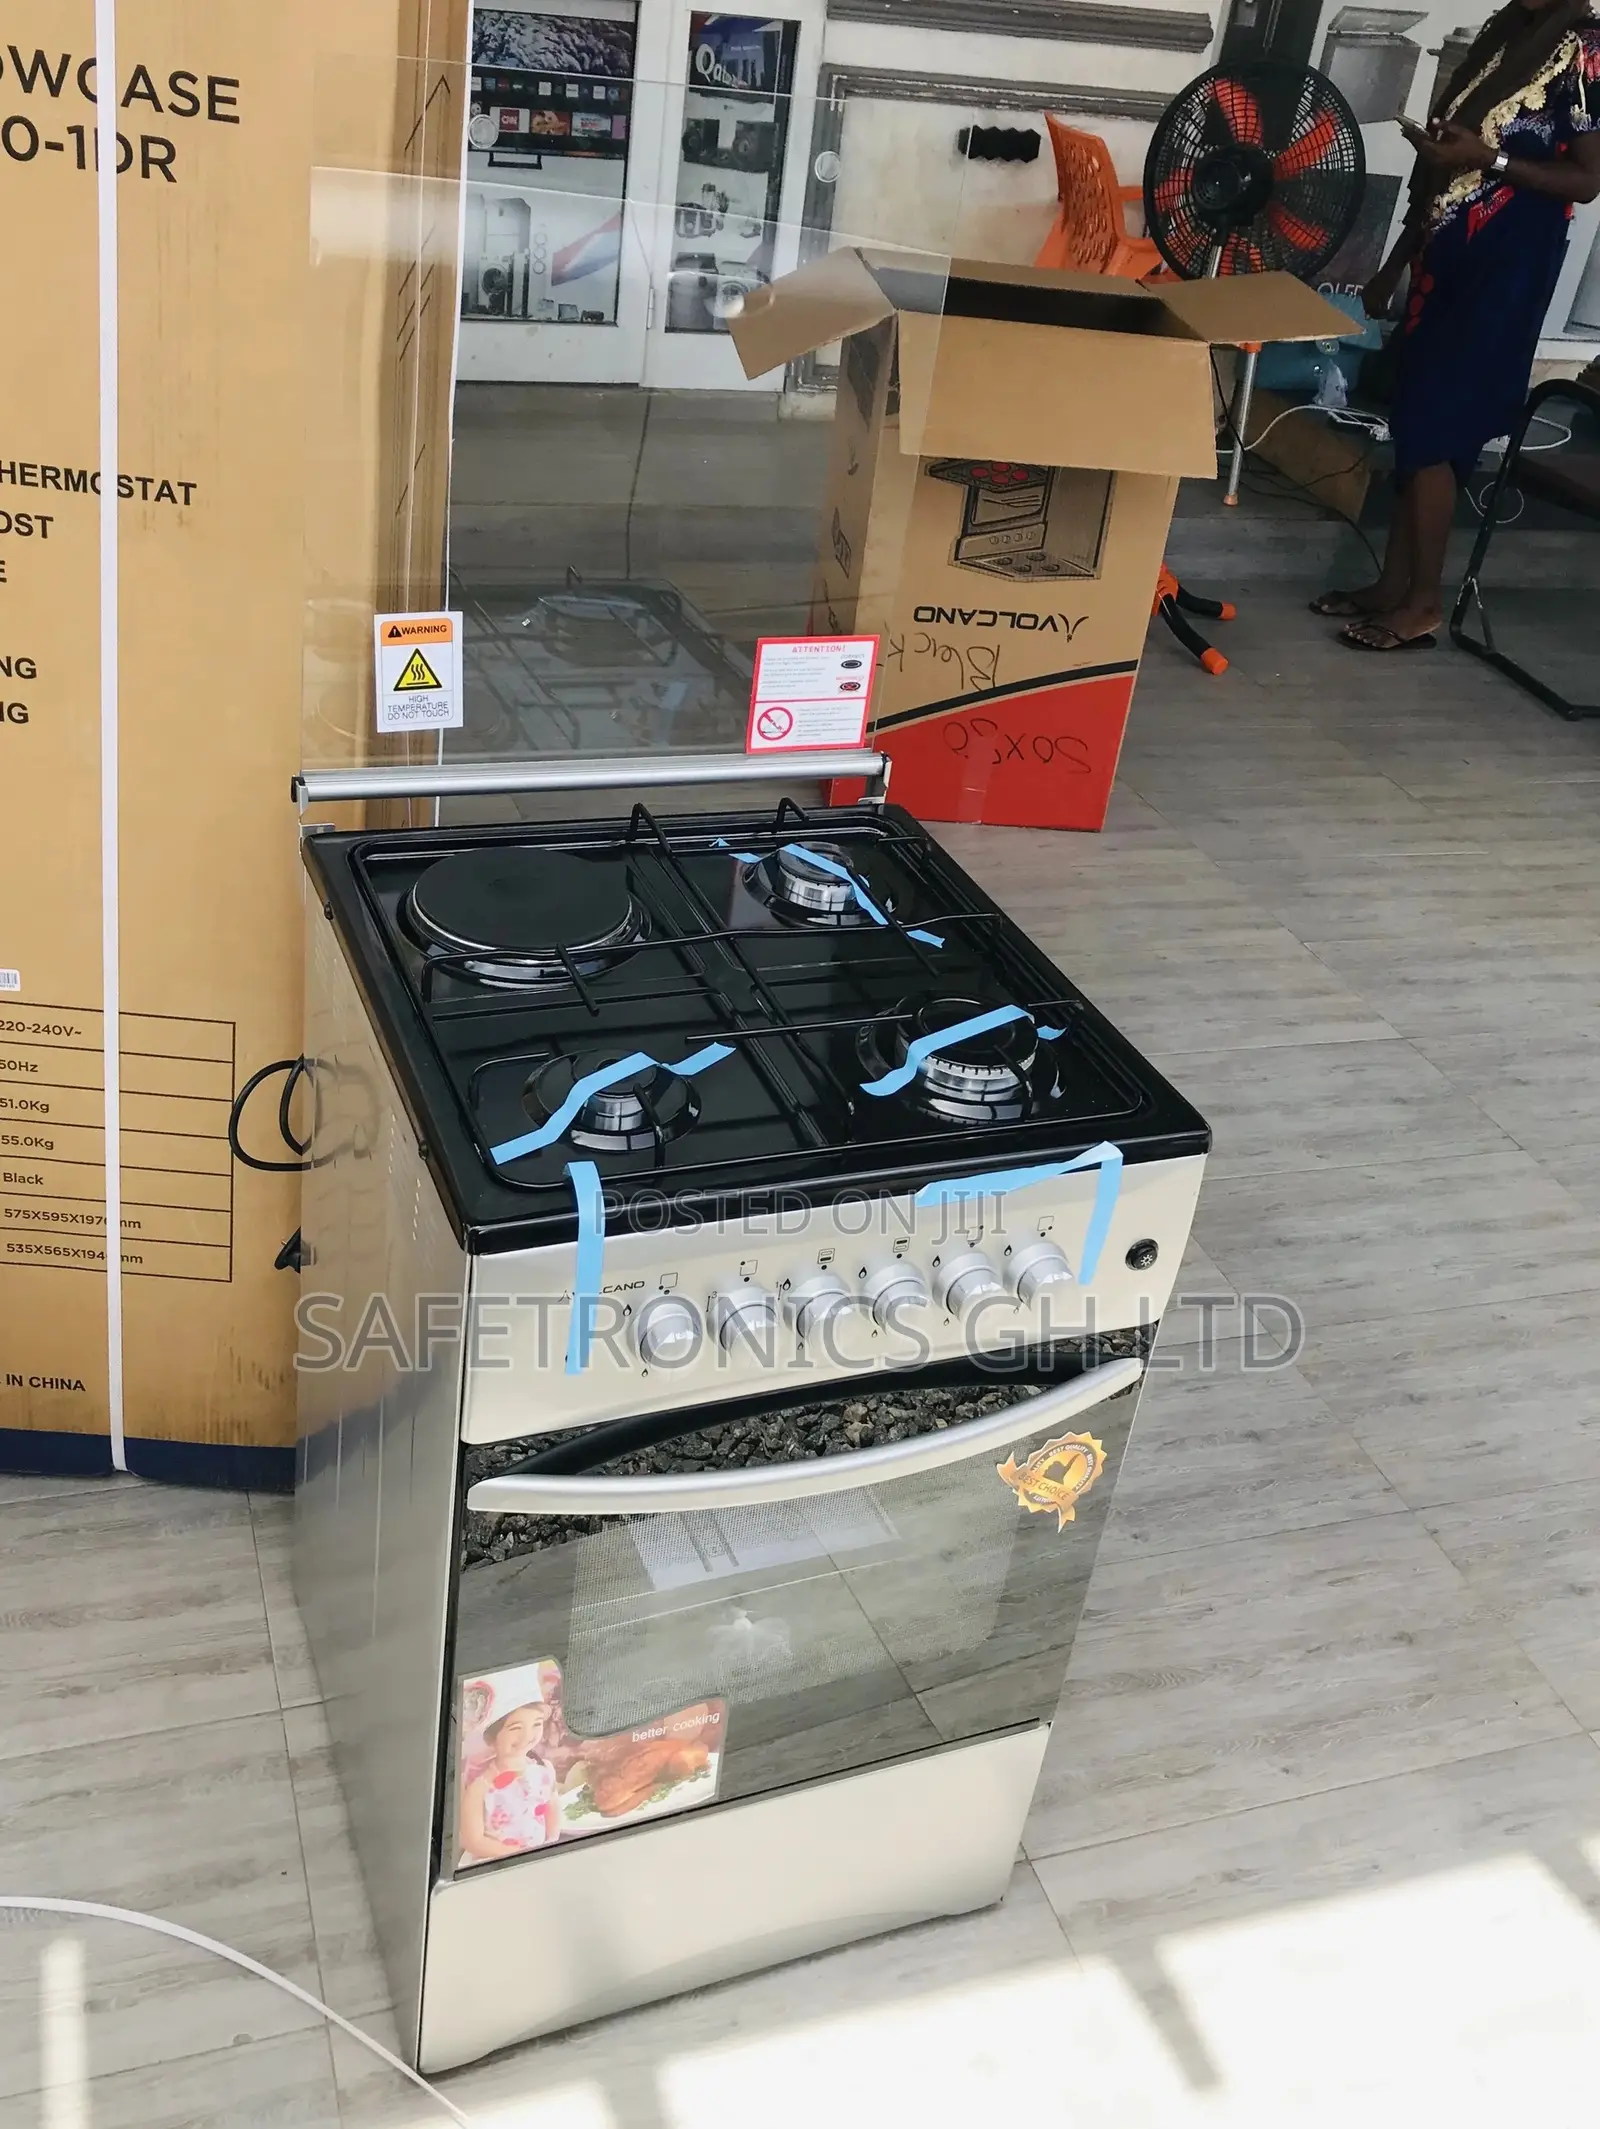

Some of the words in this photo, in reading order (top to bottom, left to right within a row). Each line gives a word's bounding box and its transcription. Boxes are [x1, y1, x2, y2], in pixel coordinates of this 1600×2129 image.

[0, 45, 240, 124] WCASE
[914, 606, 1059, 632] VOLCANO
[401, 624, 448, 635] WARNING
[791, 645, 847, 653] ATTENTION!
[388, 701, 449, 712] TEMPERATURE
[408, 695, 429, 703] HIGH
[0, 702, 29, 724] G
[402, 711, 420, 719] NOT
[422, 709, 449, 718] TOUCH
[0, 1098, 50, 1114] 51.0Kg
[1, 1135, 54, 1151] 55.0Kg
[3, 1172, 43, 1186] Black
[4, 1208, 142, 1229] 575X595X197mm
[6, 1243, 144, 1264] 535X565X194mm
[6, 1373, 23, 1387] IN
[29, 1376, 86, 1391] CHINA
[1018, 1471, 1038, 1487] BEST
[1038, 1480, 1071, 1501] CHOICE
[631, 1724, 668, 1743] better
[672, 1711, 720, 1733] cooking
